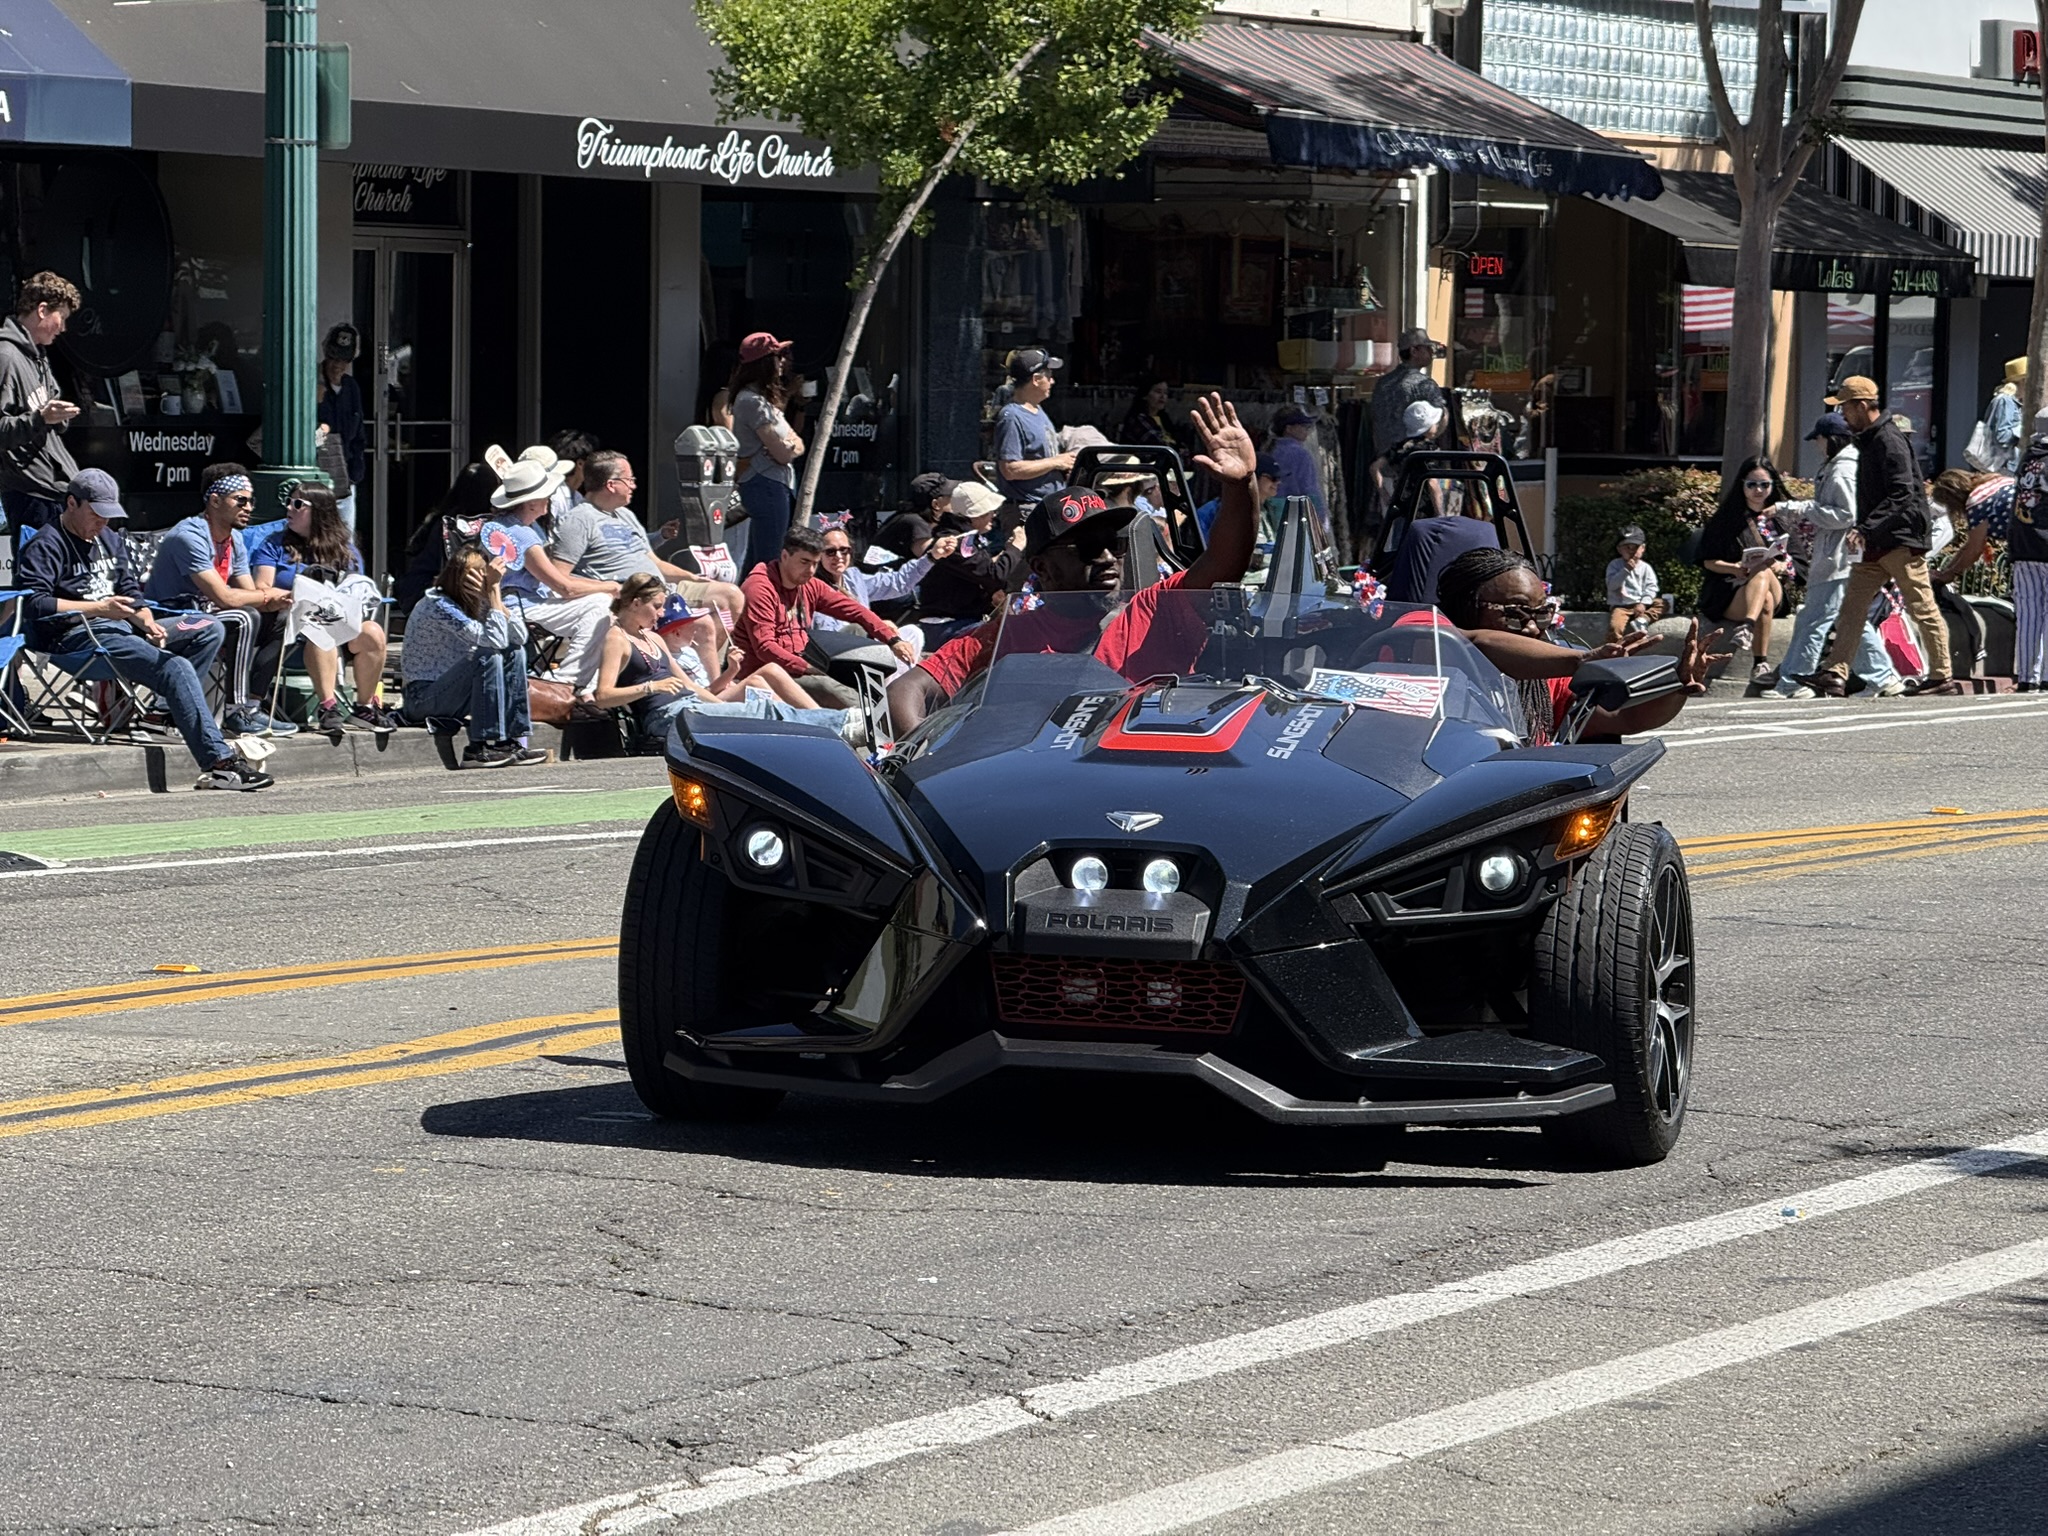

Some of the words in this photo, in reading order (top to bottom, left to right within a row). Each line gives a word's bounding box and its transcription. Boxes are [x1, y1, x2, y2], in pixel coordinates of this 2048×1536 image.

[577, 117, 711, 178] Triumphant
[710, 130, 756, 184] Life
[757, 134, 834, 179] Church
[354, 181, 413, 213] Church
[1470, 256, 1503, 275] OPEN
[1891, 269, 1939, 292] 521-4488
[814, 419, 878, 442] dnesday
[129, 430, 215, 456] Wednesday
[832, 446, 841, 464] 7
[841, 450, 860, 469] pm
[154, 462, 164, 483] 7
[166, 465, 190, 487] pm
[1365, 676, 1388, 687] NO
[1388, 678, 1427, 695] KINGS
[1050, 696, 1106, 750] SLINGSHOT
[1266, 702, 1327, 760] SLINGSHOT
[1045, 912, 1174, 933] POLARIS
